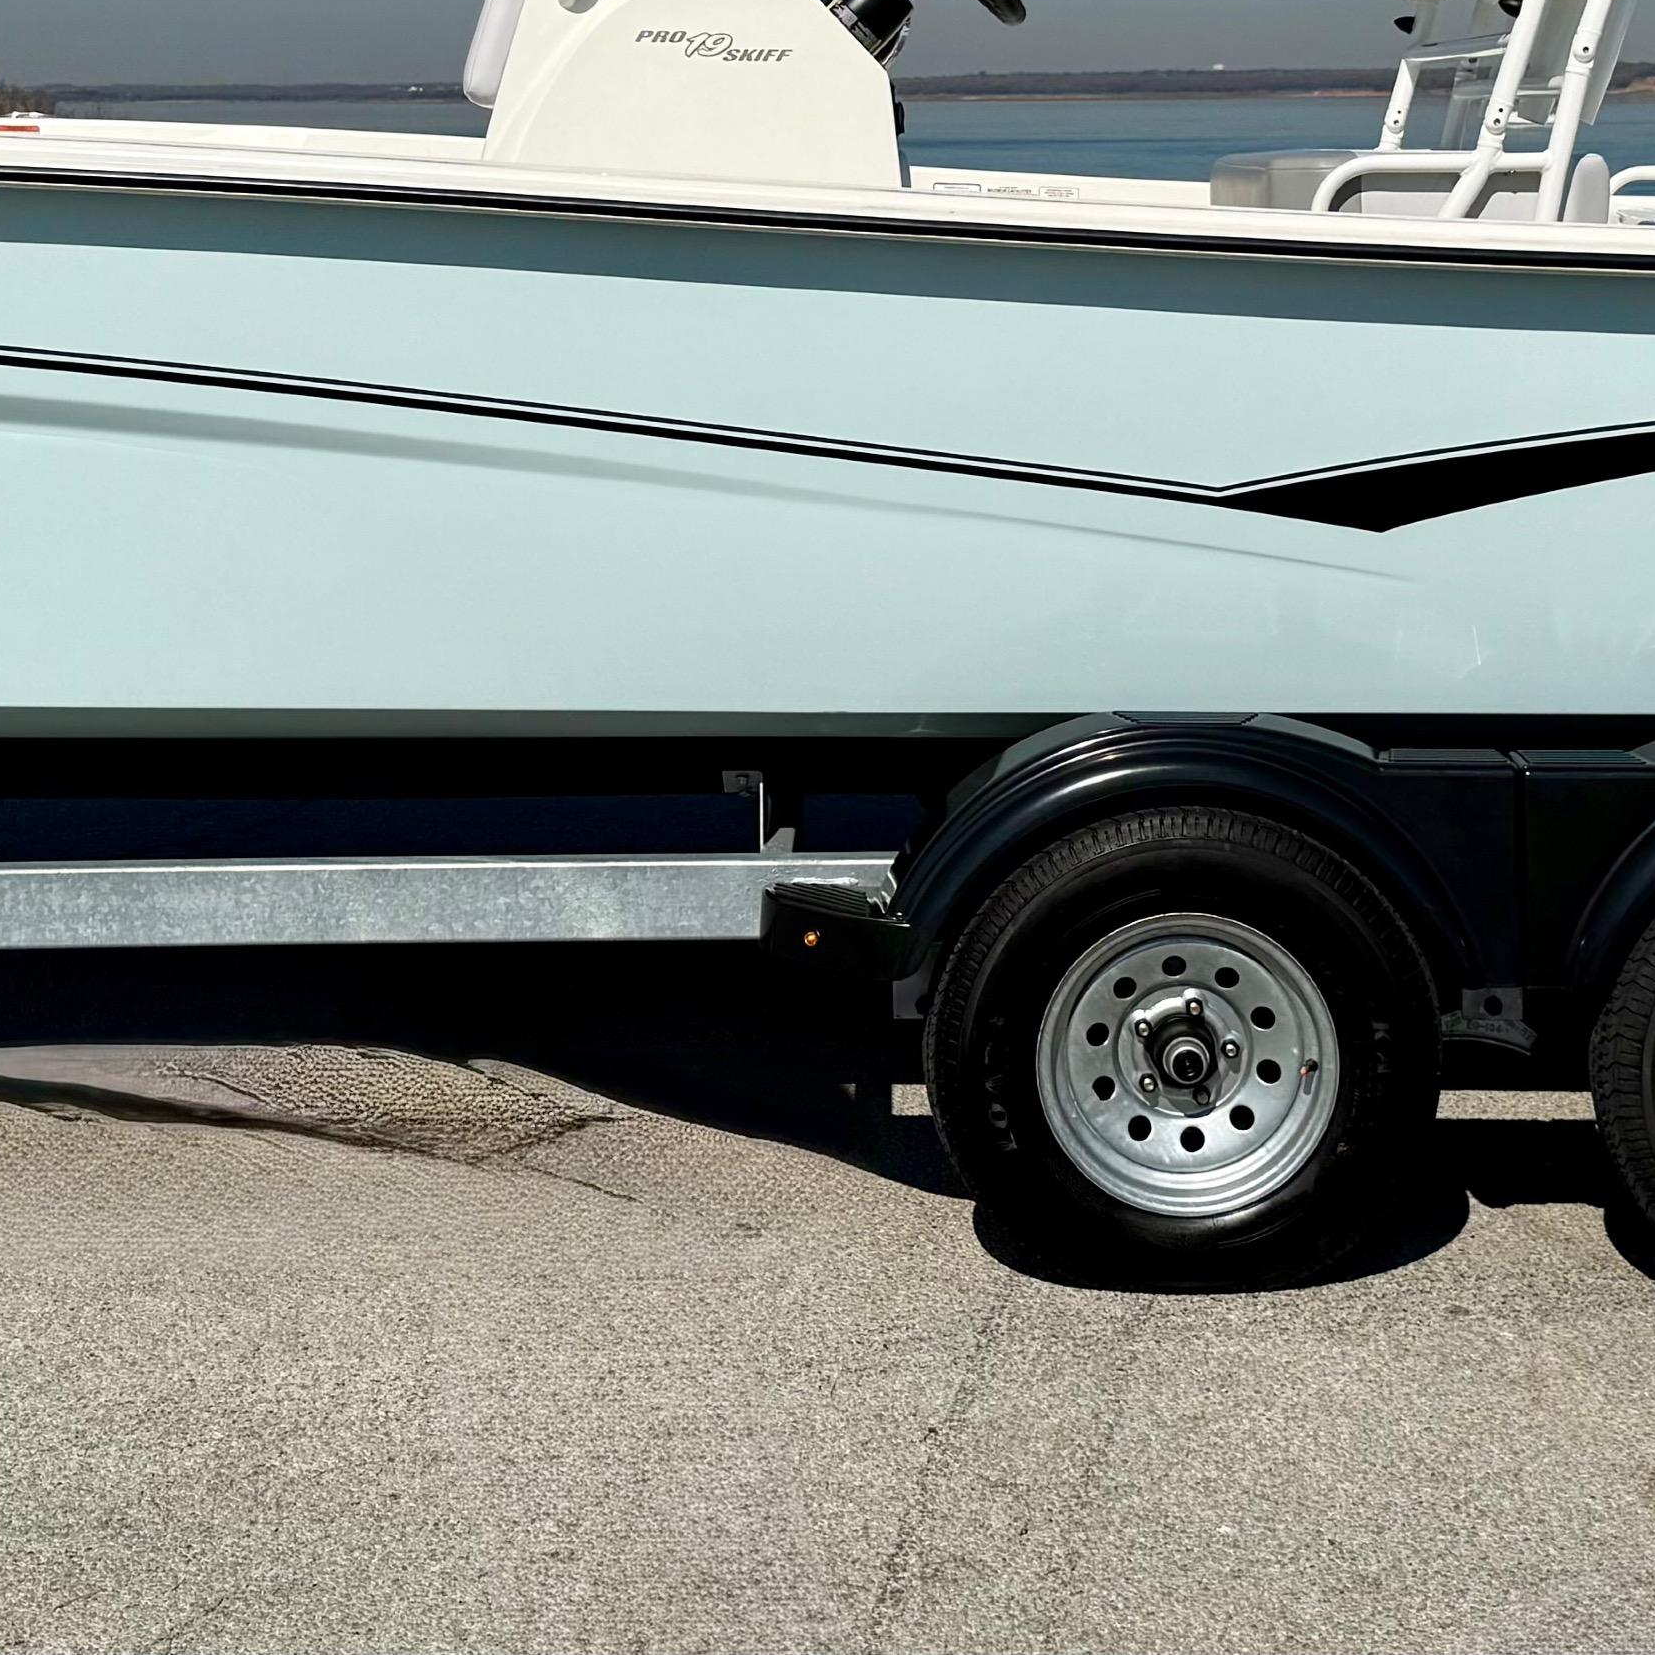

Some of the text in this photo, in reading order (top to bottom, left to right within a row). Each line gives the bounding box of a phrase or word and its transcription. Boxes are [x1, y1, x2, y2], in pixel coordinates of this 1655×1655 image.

[635, 30, 793, 62] PRO 19 SKIFF
